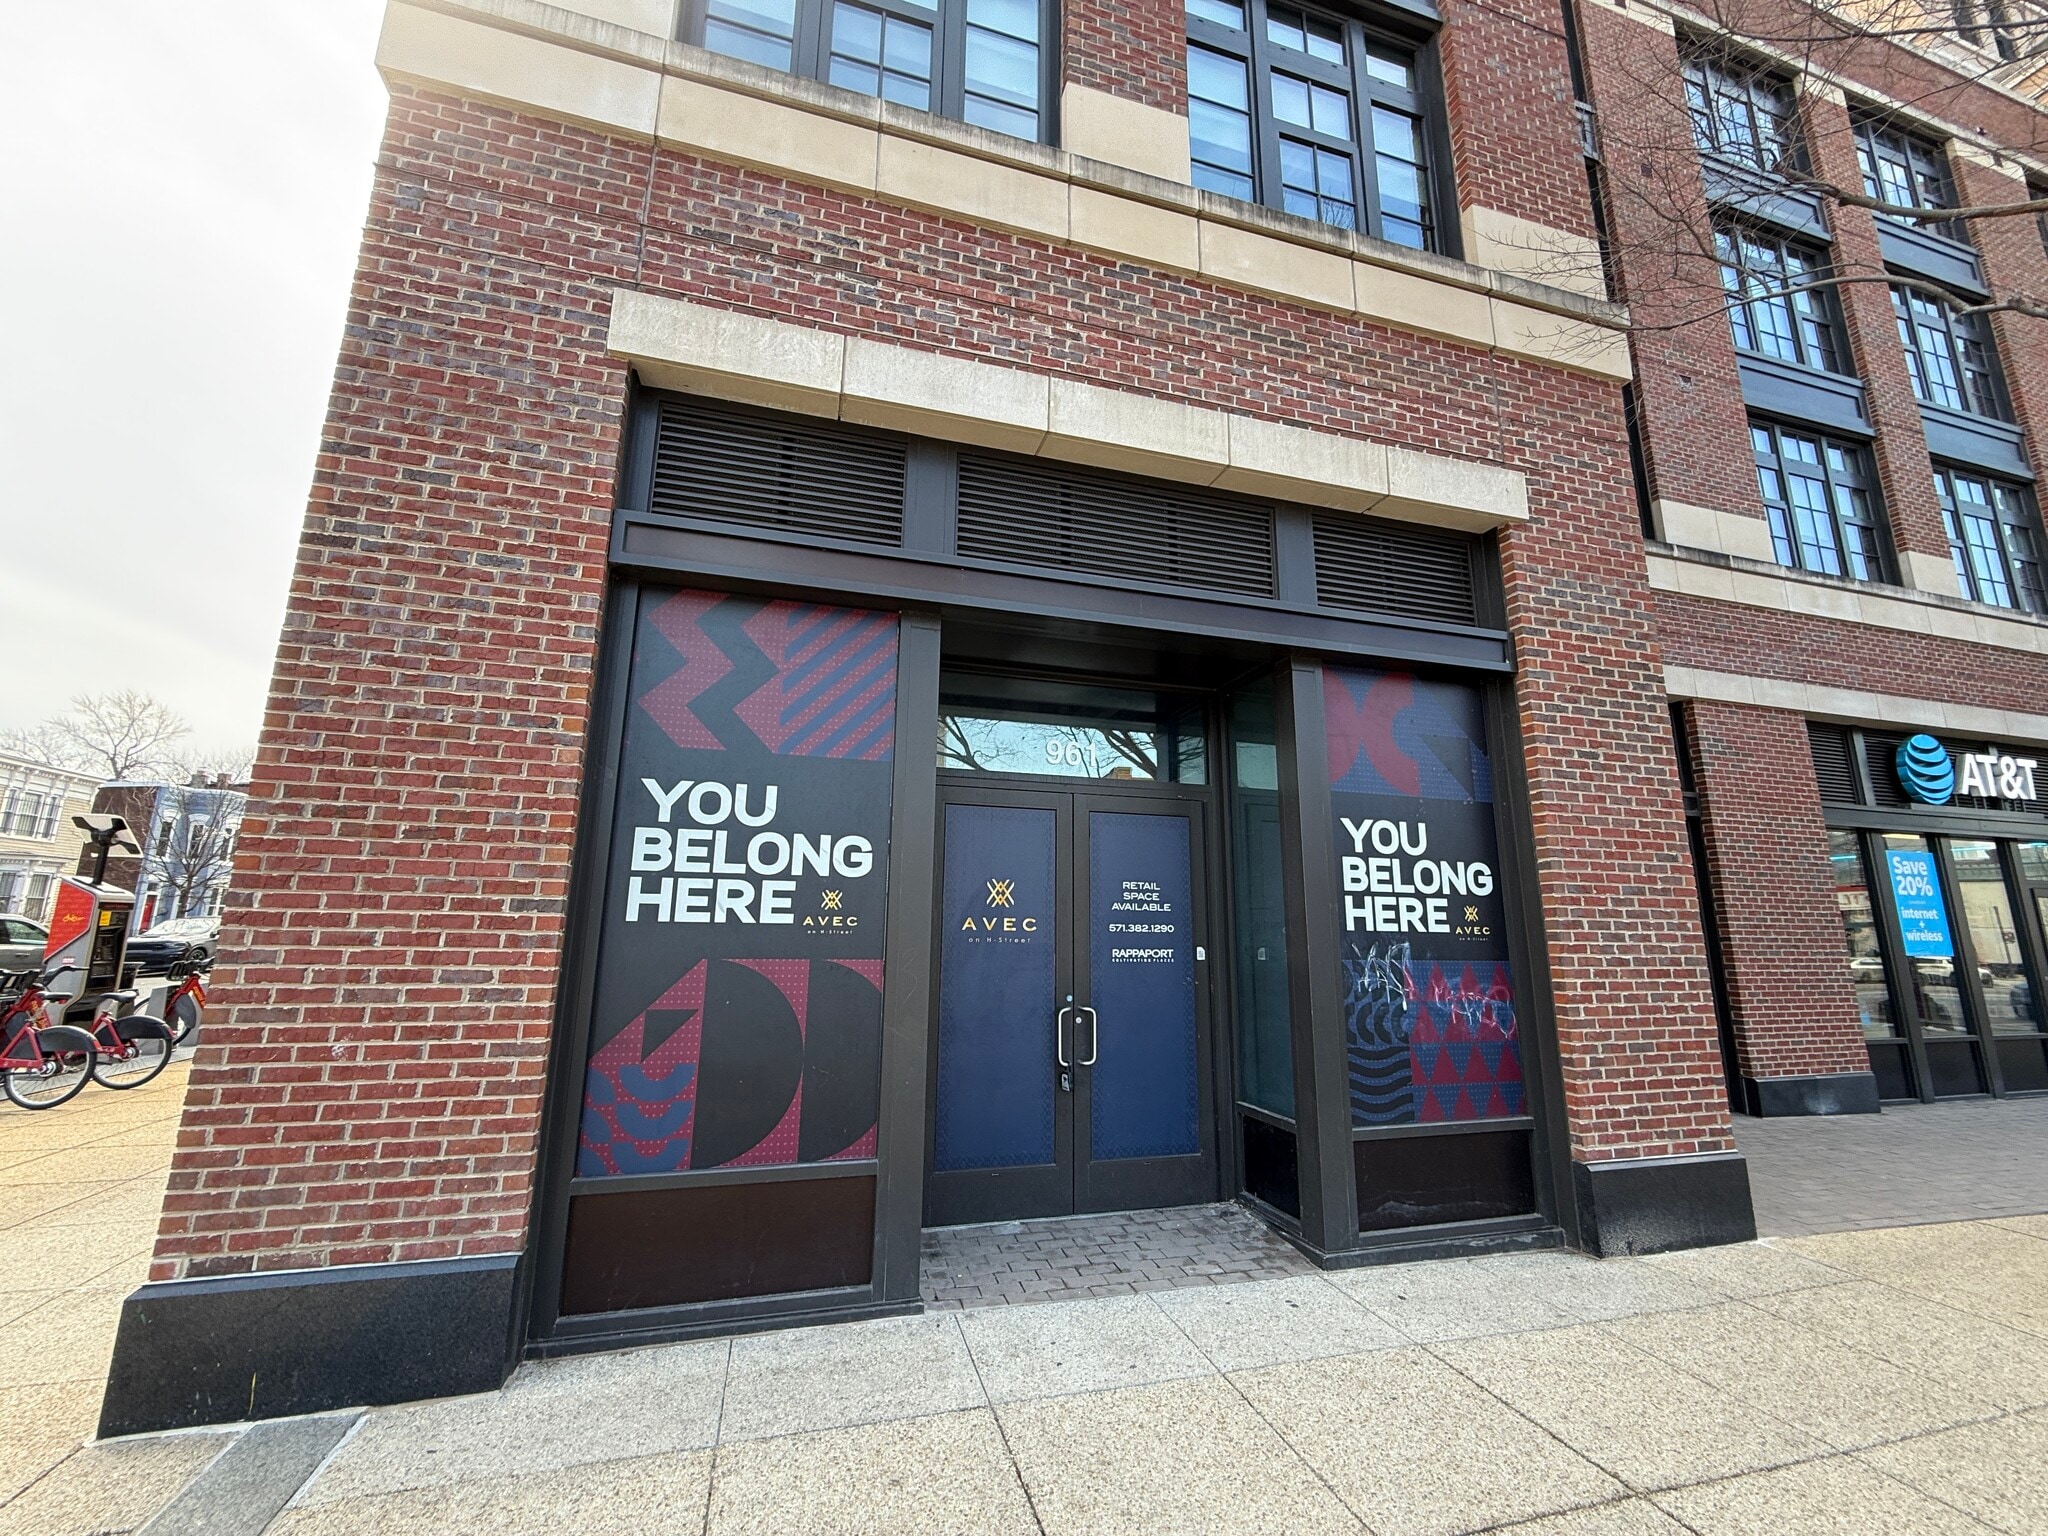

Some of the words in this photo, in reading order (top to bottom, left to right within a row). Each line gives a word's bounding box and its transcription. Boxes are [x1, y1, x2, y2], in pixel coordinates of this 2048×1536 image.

[1046, 740, 1098, 768] 961
[1958, 753, 2038, 801] AT&T
[641, 777, 779, 828] YOU
[1339, 817, 1428, 856] YOU
[630, 826, 874, 879] BELONG
[1892, 855, 1928, 876] Save
[1341, 856, 1494, 897] BELONG
[1122, 881, 1161, 890] RETAIL
[1896, 875, 1934, 897] 20%
[625, 876, 797, 925] HERE
[1123, 892, 1160, 901] SPACE
[1111, 902, 1172, 912] AVAILABLE
[1344, 895, 1451, 933] HERE
[1901, 906, 1940, 920] internet
[802, 915, 858, 927] AVEC
[961, 916, 1038, 932] AVEC
[1108, 923, 1175, 933] 571.382.1290
[1455, 926, 1491, 935] AVEC
[1905, 929, 1944, 942] wireless
[986, 936, 1031, 944] H-Street
[1112, 948, 1174, 958] RAPPAPORT
